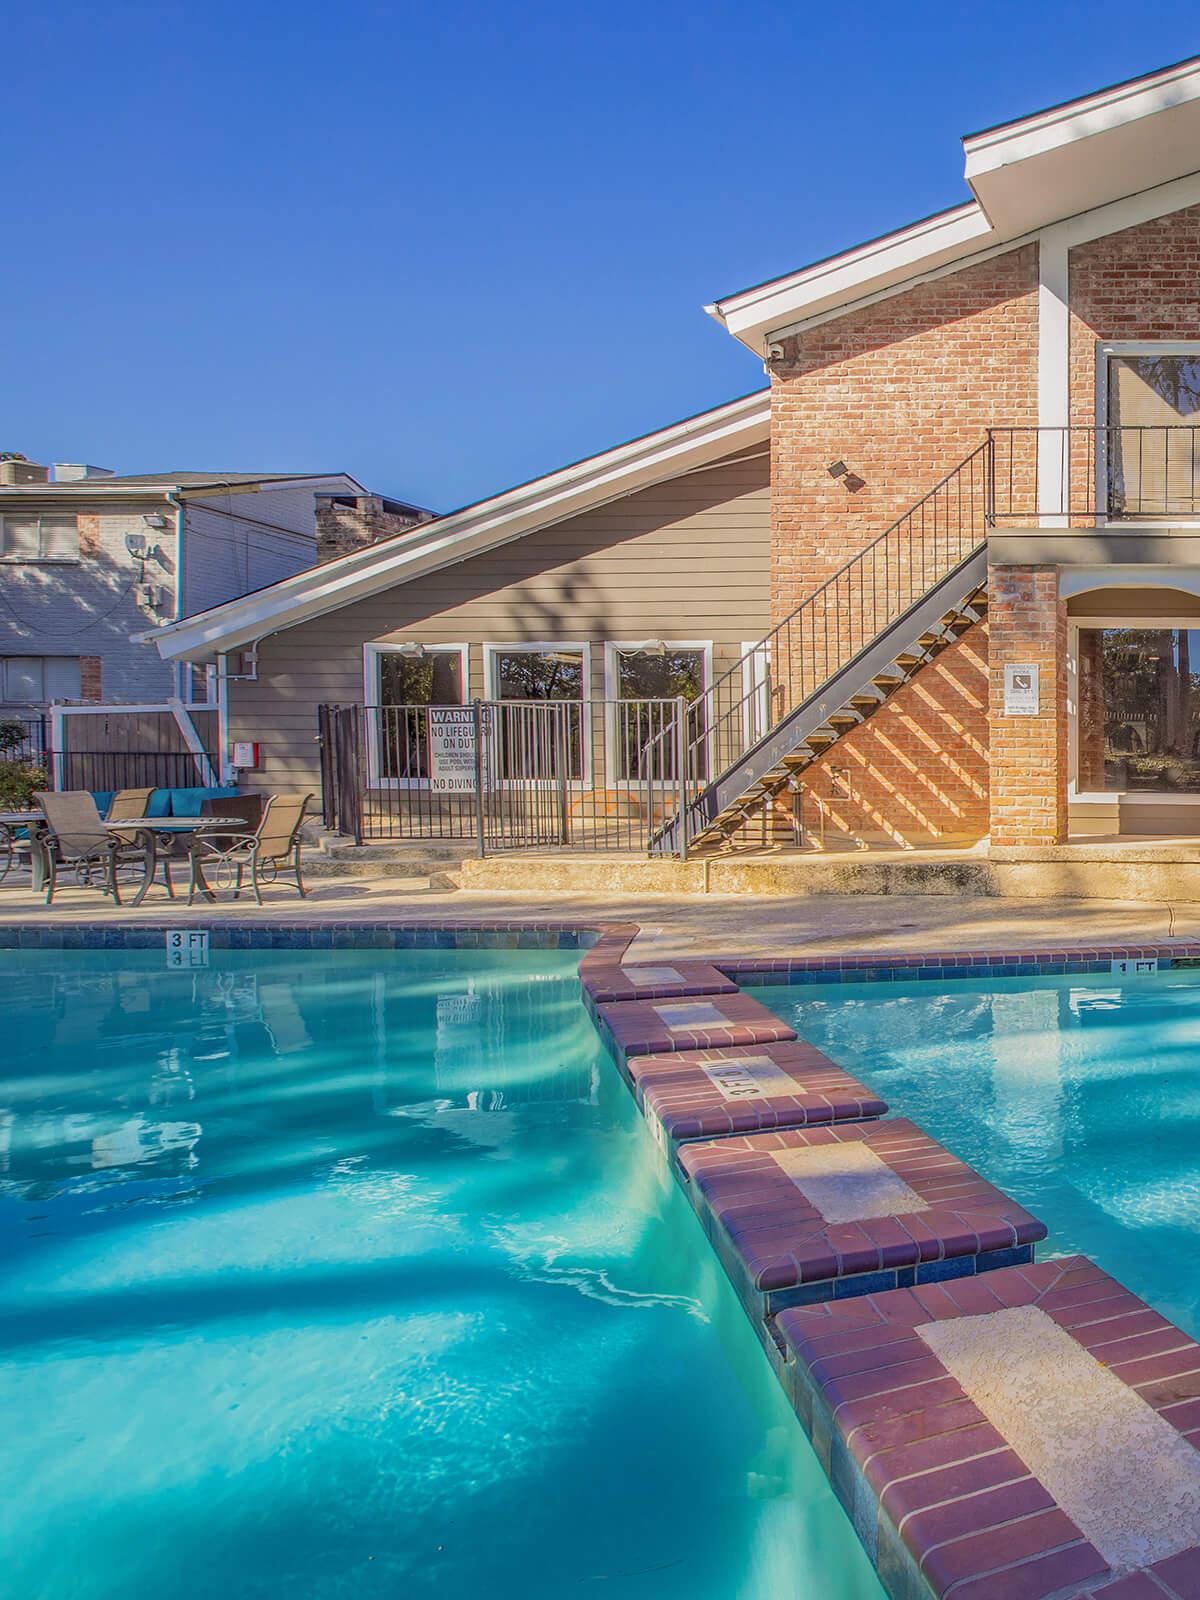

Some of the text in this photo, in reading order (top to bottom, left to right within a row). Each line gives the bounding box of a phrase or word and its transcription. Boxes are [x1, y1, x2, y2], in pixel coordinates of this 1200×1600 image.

[431, 726, 444, 737] NO
[443, 738, 476, 748] ON DUT
[433, 778, 446, 789] NO
[172, 933, 206, 947] 3 FT
[1119, 962, 1155, 971] 1 FT
[719, 1078, 755, 1088] FT
[728, 1088, 760, 1096] 3
